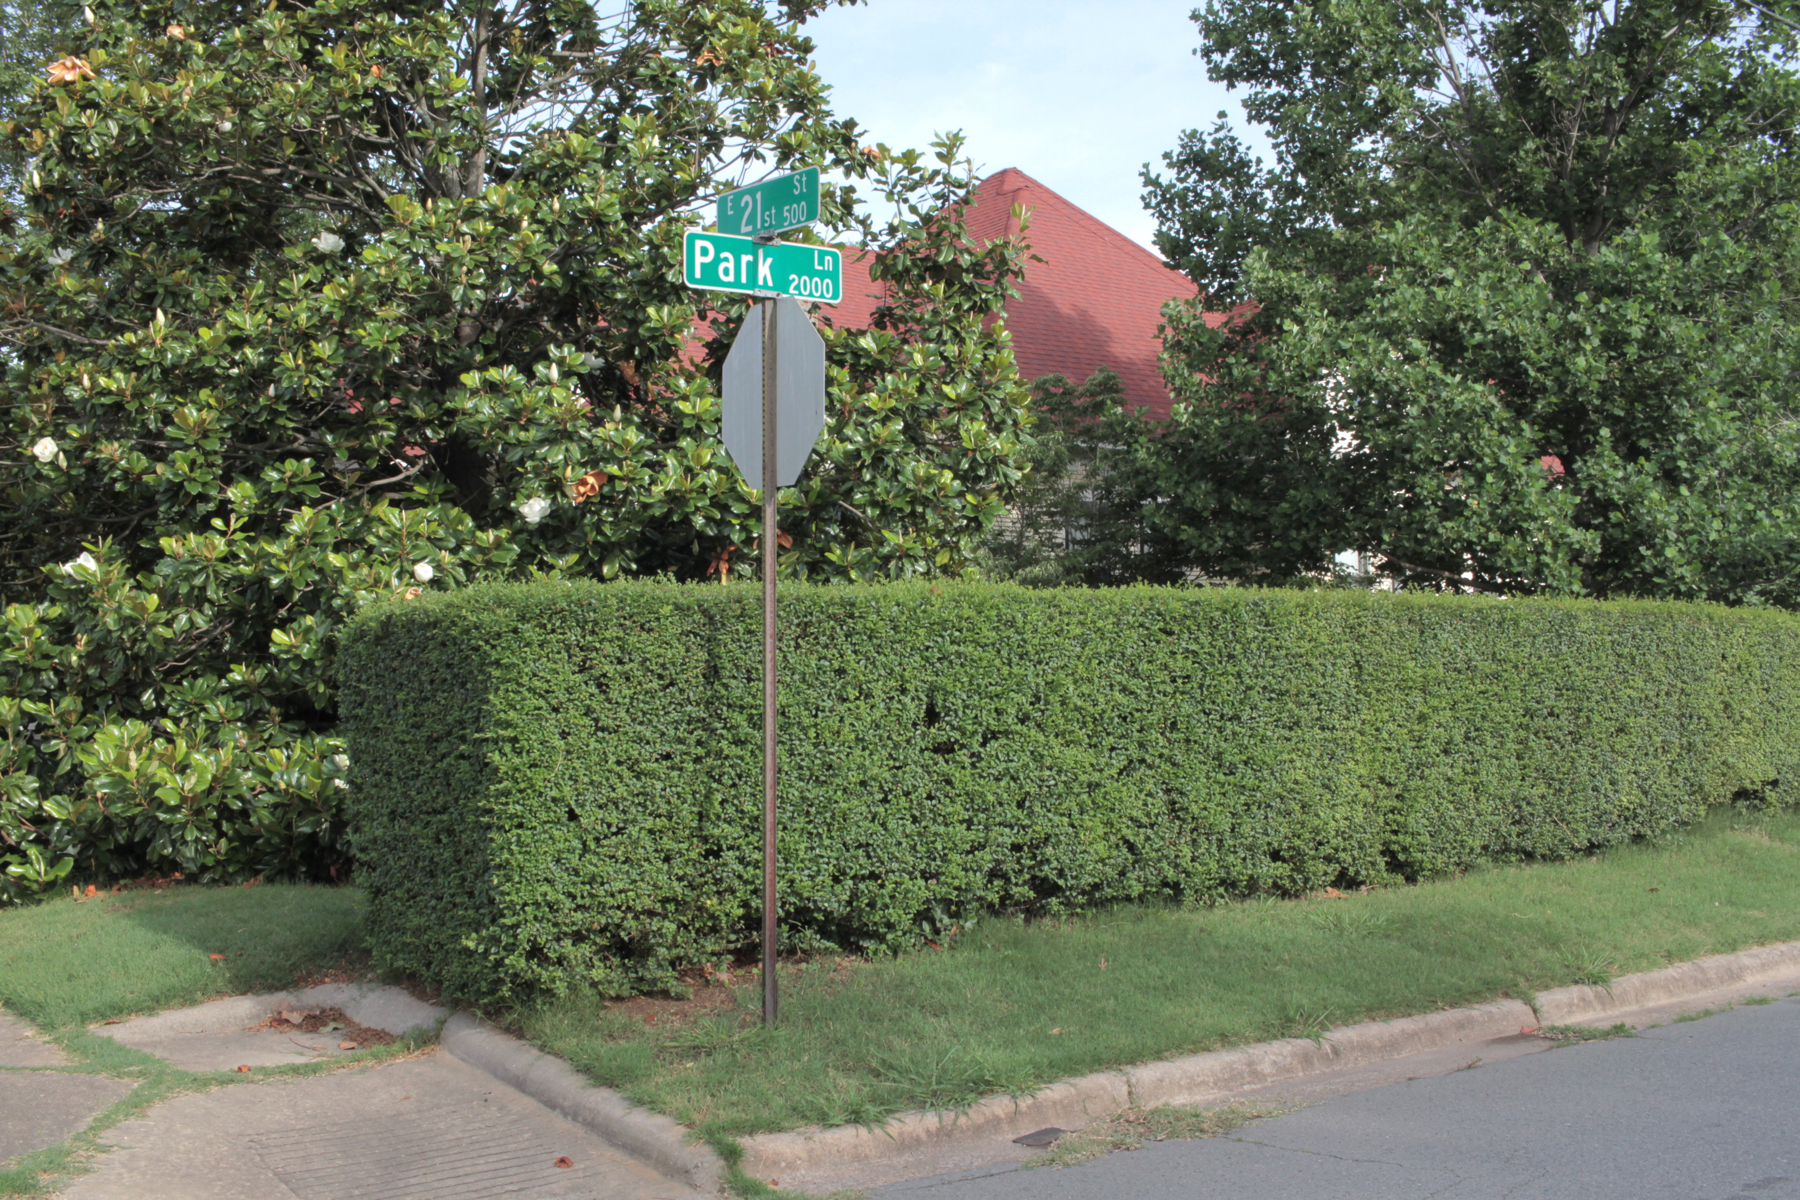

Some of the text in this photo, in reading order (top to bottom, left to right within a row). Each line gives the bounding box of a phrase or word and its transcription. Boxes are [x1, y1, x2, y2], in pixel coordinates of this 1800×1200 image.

[727, 173, 807, 234] E 21st St
[783, 201, 807, 226] 500
[694, 239, 833, 287] Park Ln
[788, 274, 833, 298] 2000
